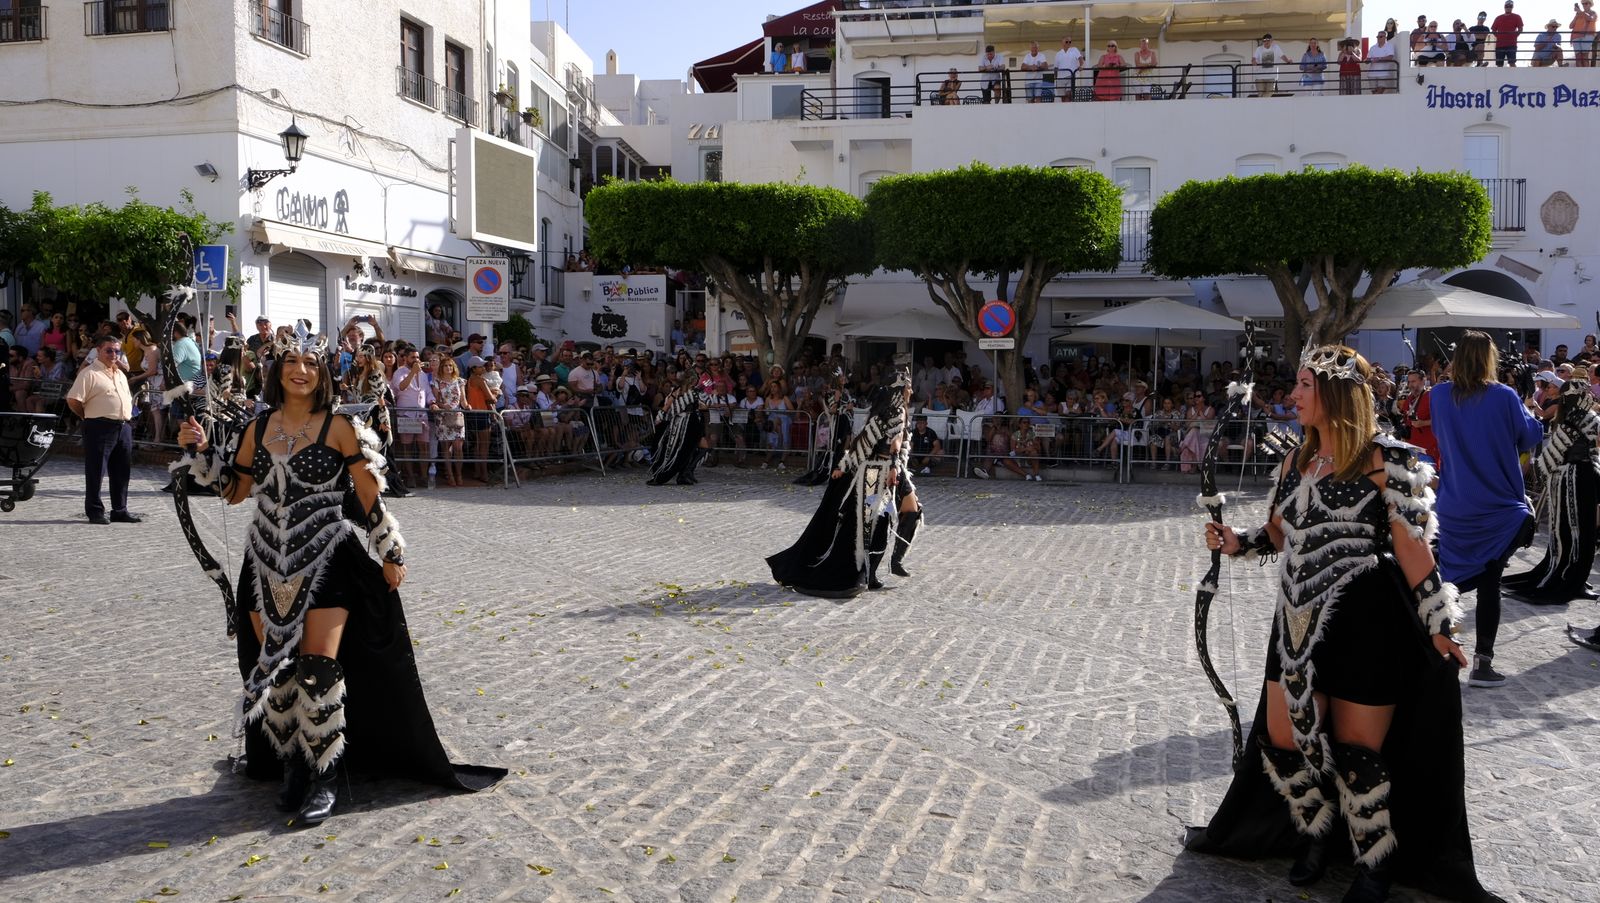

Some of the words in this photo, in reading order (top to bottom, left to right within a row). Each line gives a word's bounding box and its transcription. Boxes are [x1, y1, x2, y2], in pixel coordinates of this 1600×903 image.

[1426, 84, 1492, 108] Hostal
[1499, 84, 1546, 108] Arco
[1553, 84, 1600, 108] Plaz
[345, 275, 357, 290] La
[358, 283, 377, 293] casa
[627, 287, 659, 297] Pública
[1104, 299, 1129, 308] Bar
[1056, 348, 1077, 357] ATM
